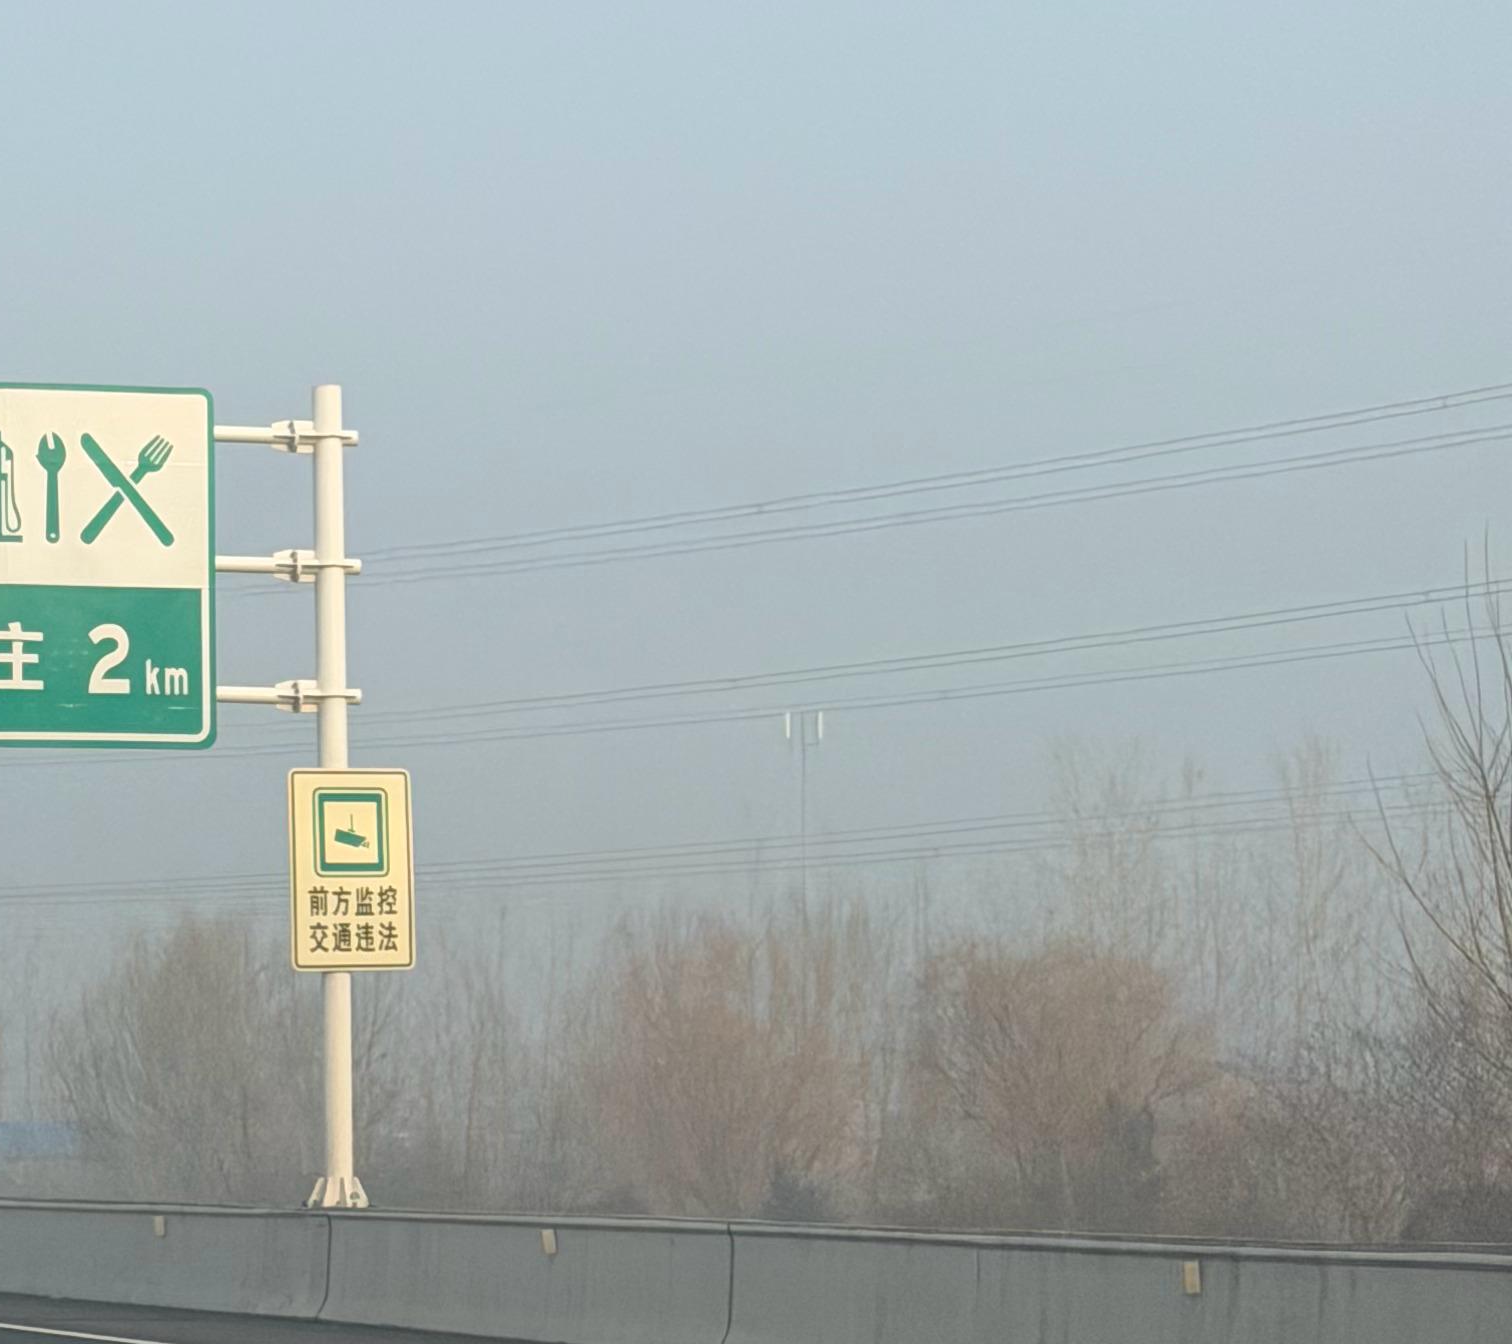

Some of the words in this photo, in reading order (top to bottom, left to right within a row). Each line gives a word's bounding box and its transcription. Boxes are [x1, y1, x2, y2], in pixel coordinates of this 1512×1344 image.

[88, 623, 131, 695] 2
[144, 658, 190, 696] km
[308, 885, 398, 917] 前方监控
[309, 921, 399, 953] 交通违法
